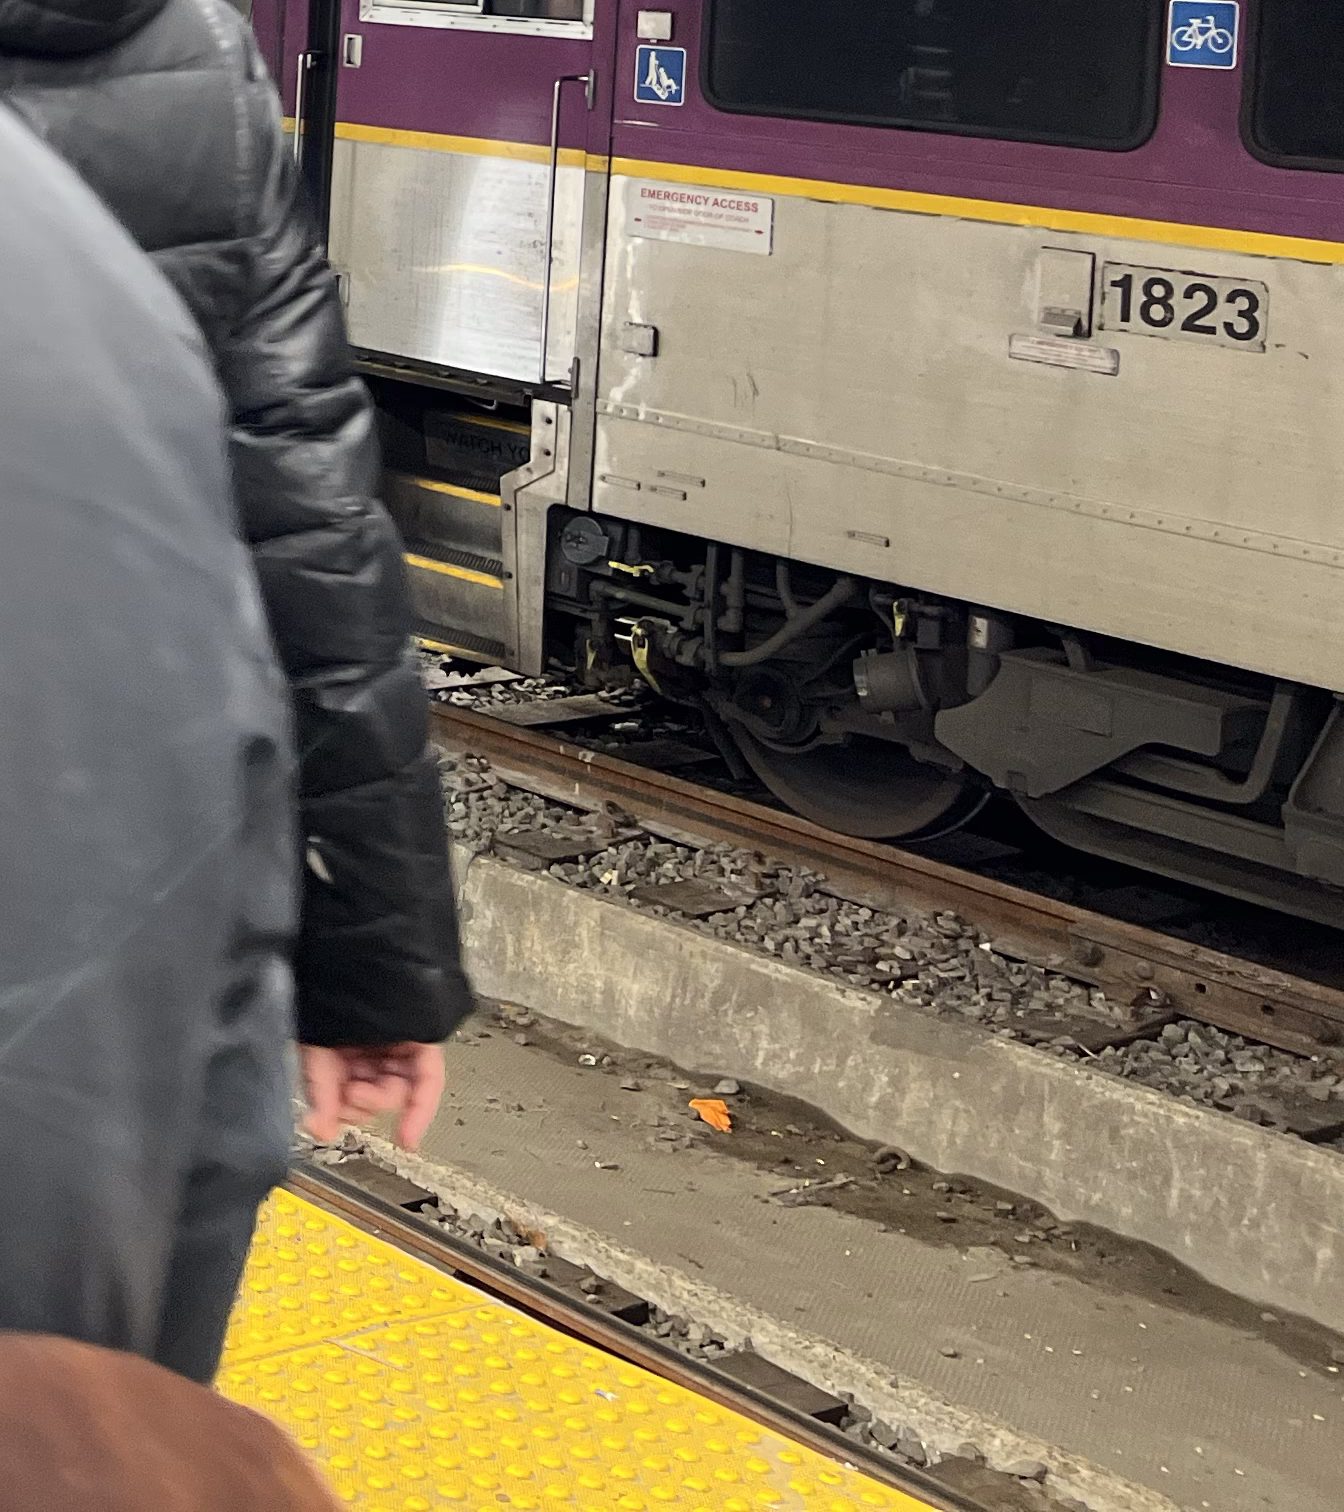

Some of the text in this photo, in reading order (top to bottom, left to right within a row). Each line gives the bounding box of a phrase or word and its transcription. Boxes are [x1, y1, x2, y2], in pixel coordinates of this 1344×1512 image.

[640, 188, 759, 213] EMERGENCY ACCESS
[1110, 273, 1260, 341] 1823
